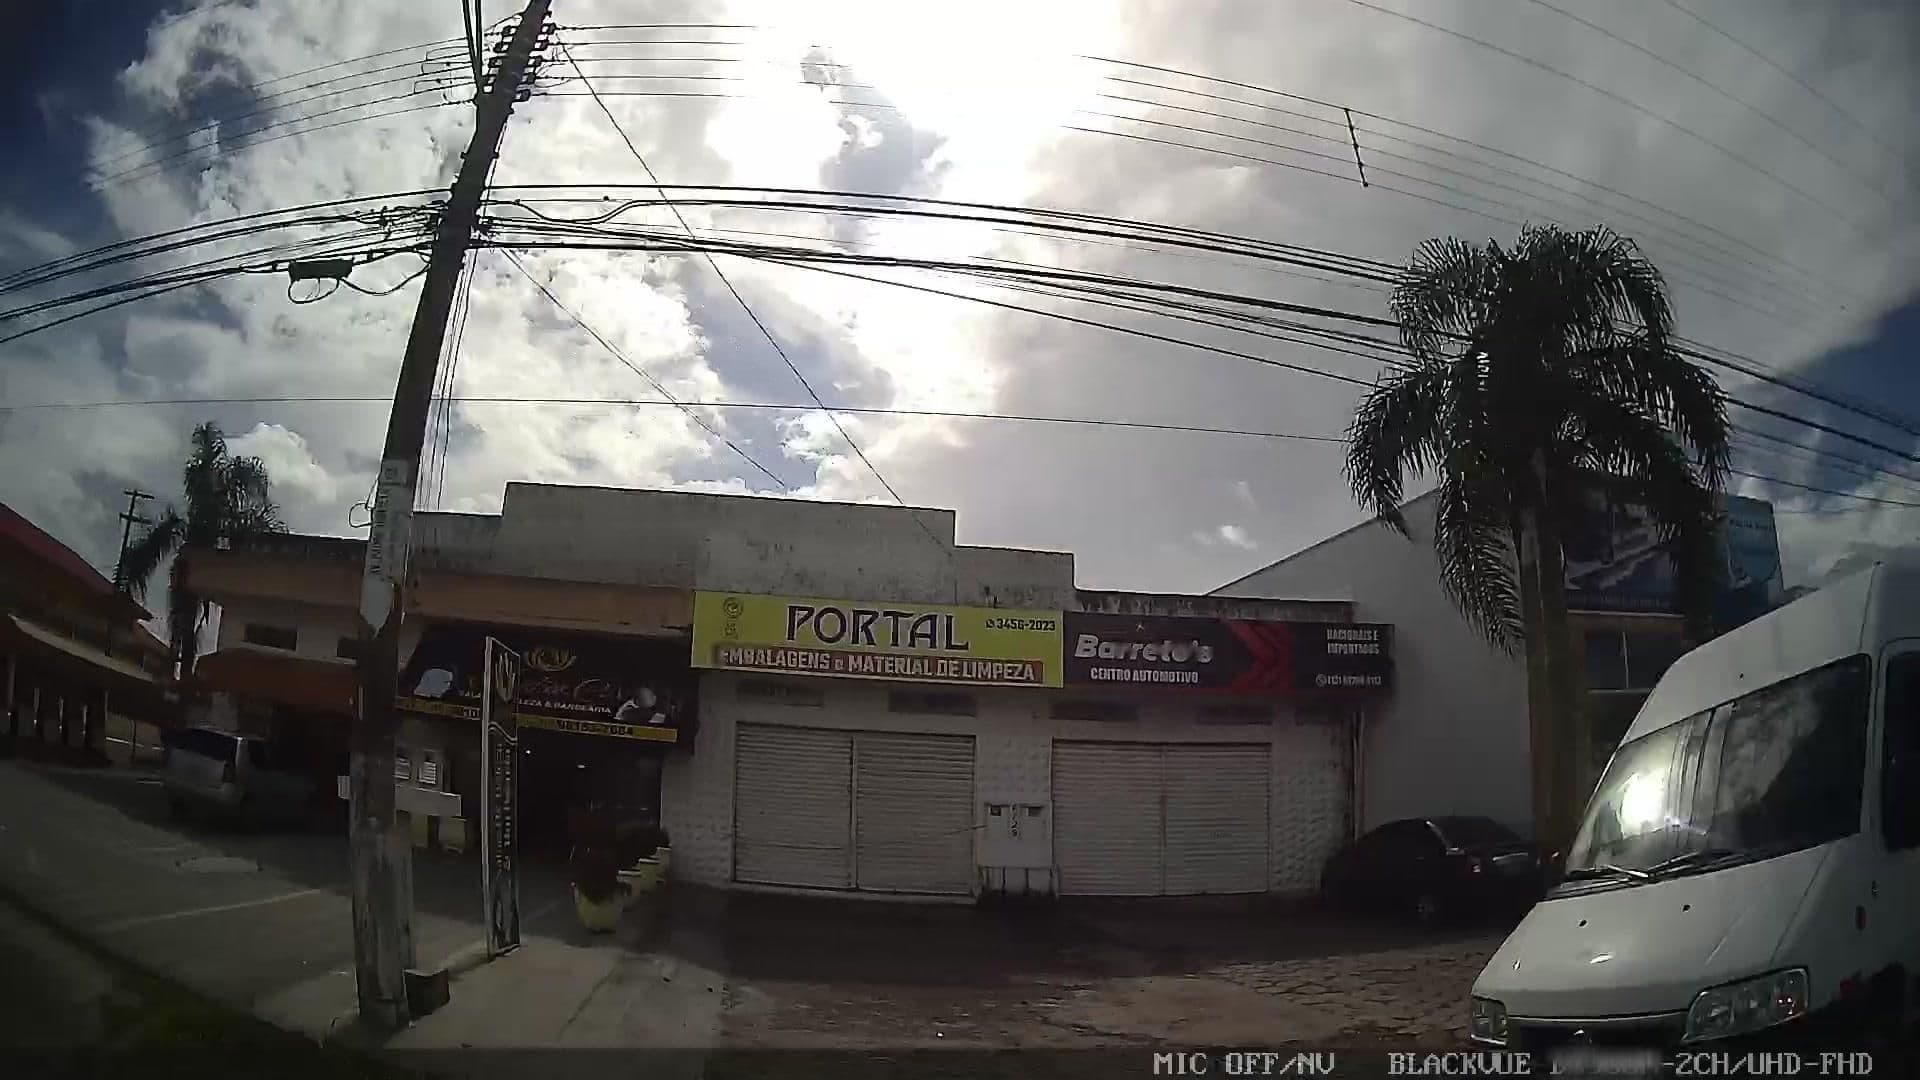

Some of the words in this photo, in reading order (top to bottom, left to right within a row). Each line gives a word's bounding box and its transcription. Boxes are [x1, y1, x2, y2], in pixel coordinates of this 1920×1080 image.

[785, 604, 969, 651] PORTAL
[996, 619, 1056, 631] 3456-2023
[1073, 633, 1214, 664] Barreto's
[719, 648, 831, 670] EMBALAGENS
[847, 655, 933, 676] MATERIAL
[936, 660, 961, 677] DE
[962, 660, 1035, 681] LIMPEZA
[1090, 667, 1131, 682] CENTRO
[1132, 668, 1200, 684] AUTOMOTIVO
